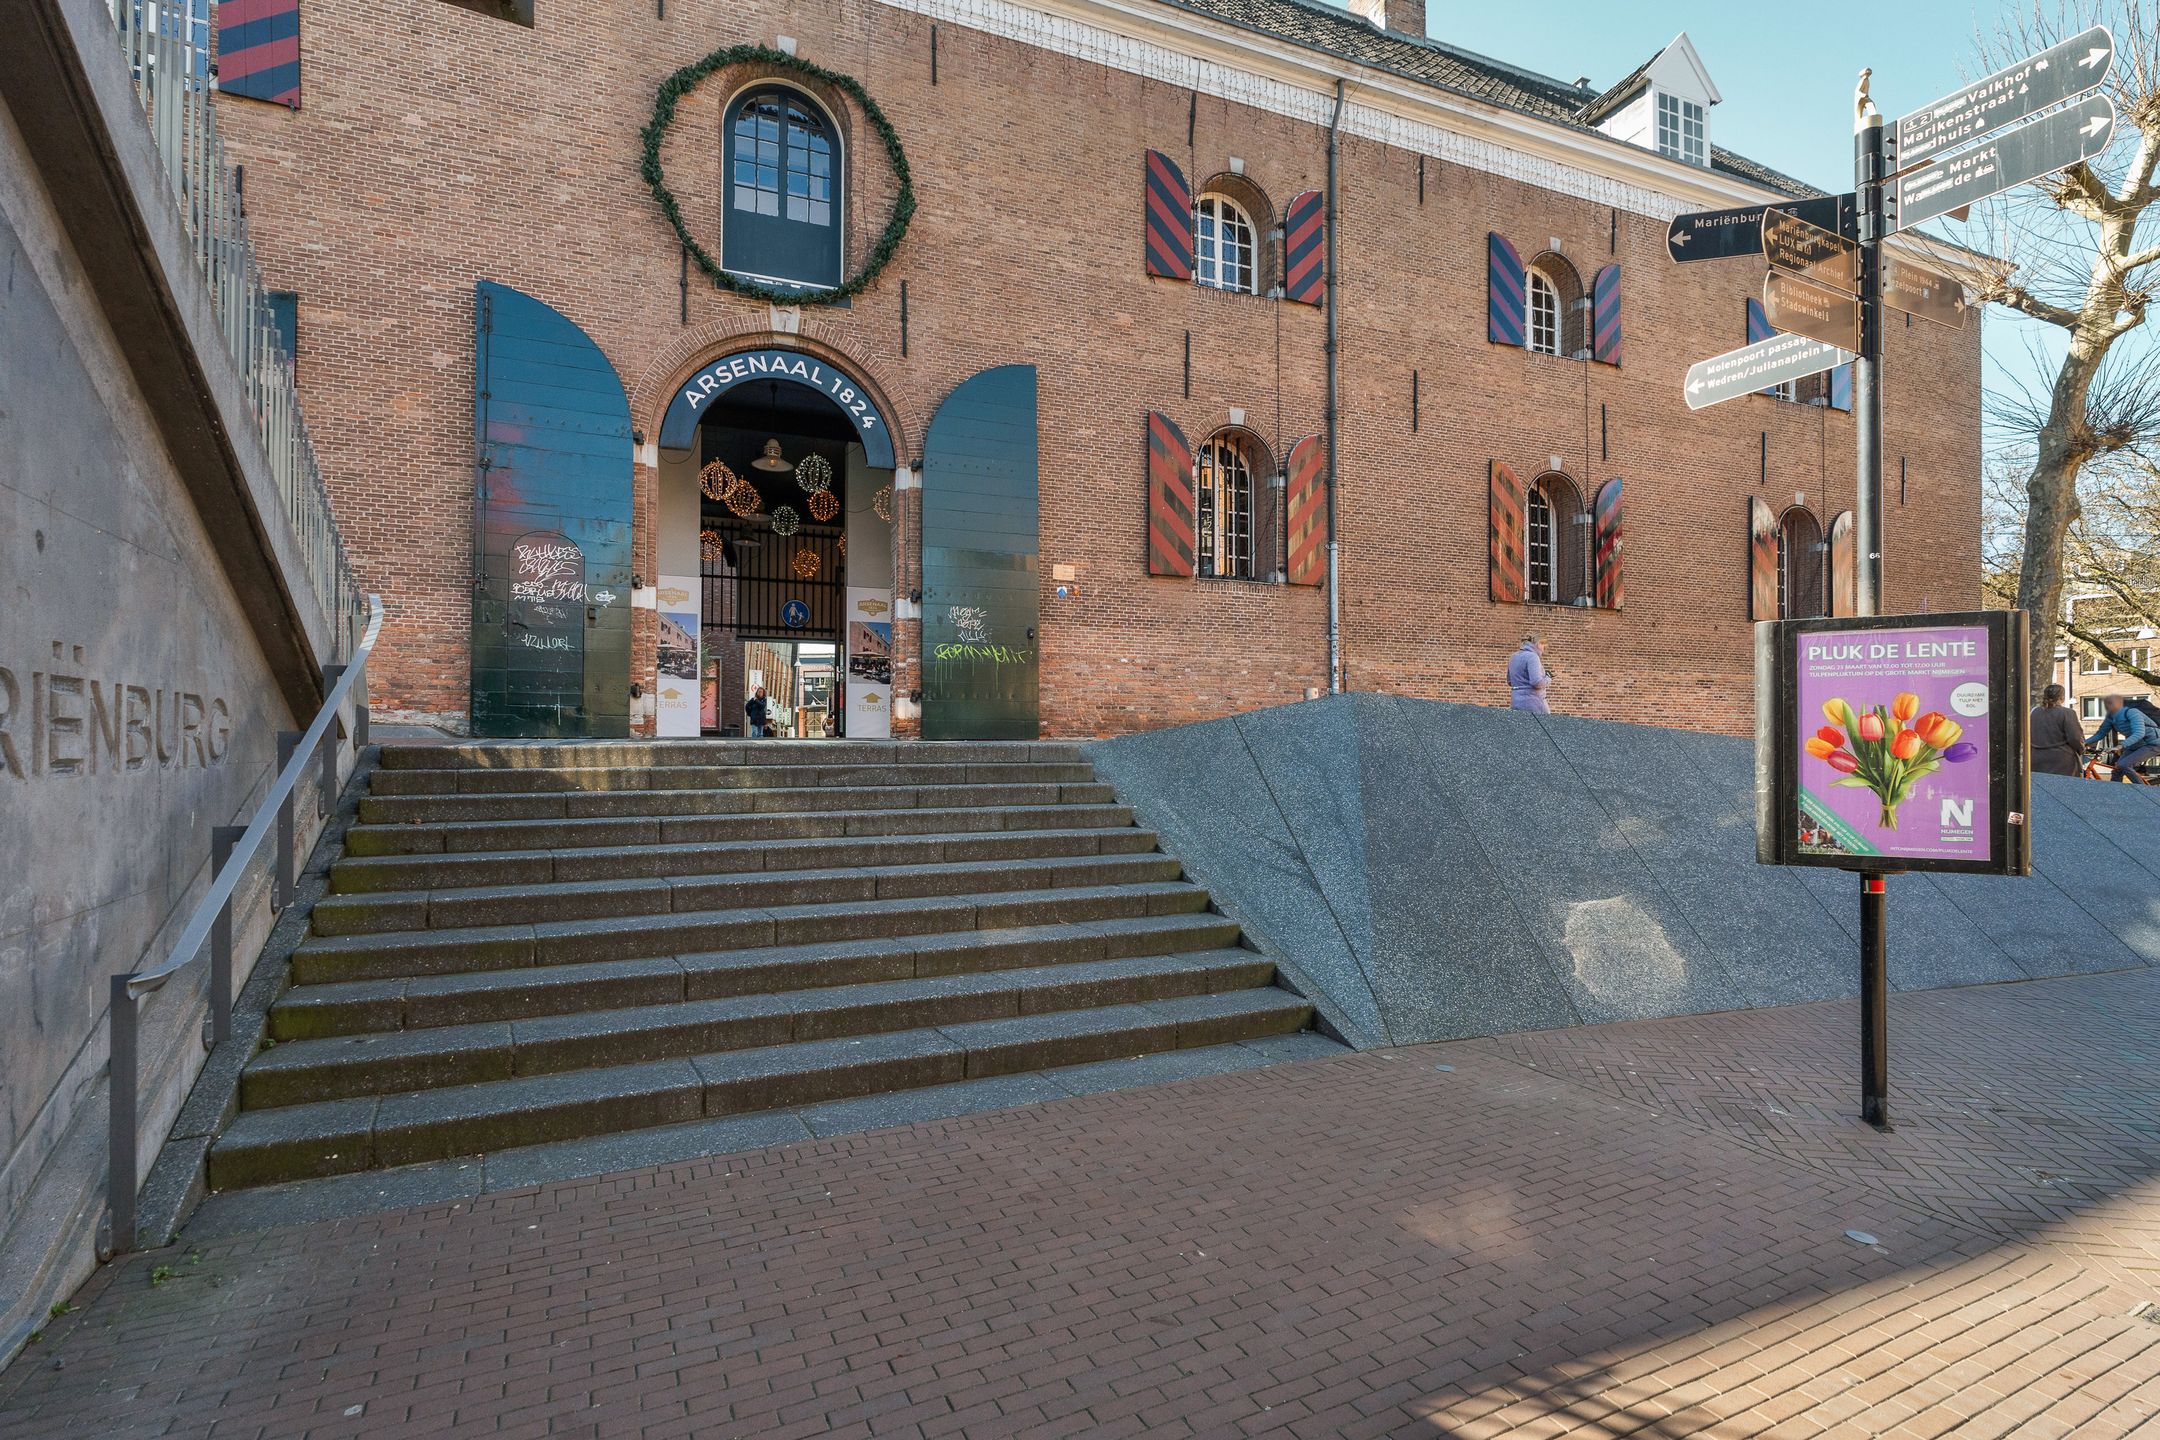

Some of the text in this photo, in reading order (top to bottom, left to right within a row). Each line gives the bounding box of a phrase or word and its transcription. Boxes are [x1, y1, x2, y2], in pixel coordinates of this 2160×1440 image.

[1967, 65, 2031, 103] Valkhof
[1903, 88, 2015, 147] Marikenstraat
[1949, 146, 1997, 175] Markt
[1779, 219, 1840, 253] Mariënburgkapel
[1779, 234, 1796, 249] LUX
[1779, 248, 1844, 281] Regionaal Archief
[1901, 267, 1918, 283] Plein
[1919, 275, 1933, 288] 1944
[1780, 281, 1823, 306] Bibliotheek
[1707, 348, 1765, 376] Molenpoort
[1707, 345, 1820, 389] Wedren/Julianaplein
[684, 355, 877, 430] ARSENAAL 1824
[1808, 641, 1976, 661] PLUK DE LENTE
[857, 704, 887, 712] TERRAS
[1941, 799, 1974, 827] N
